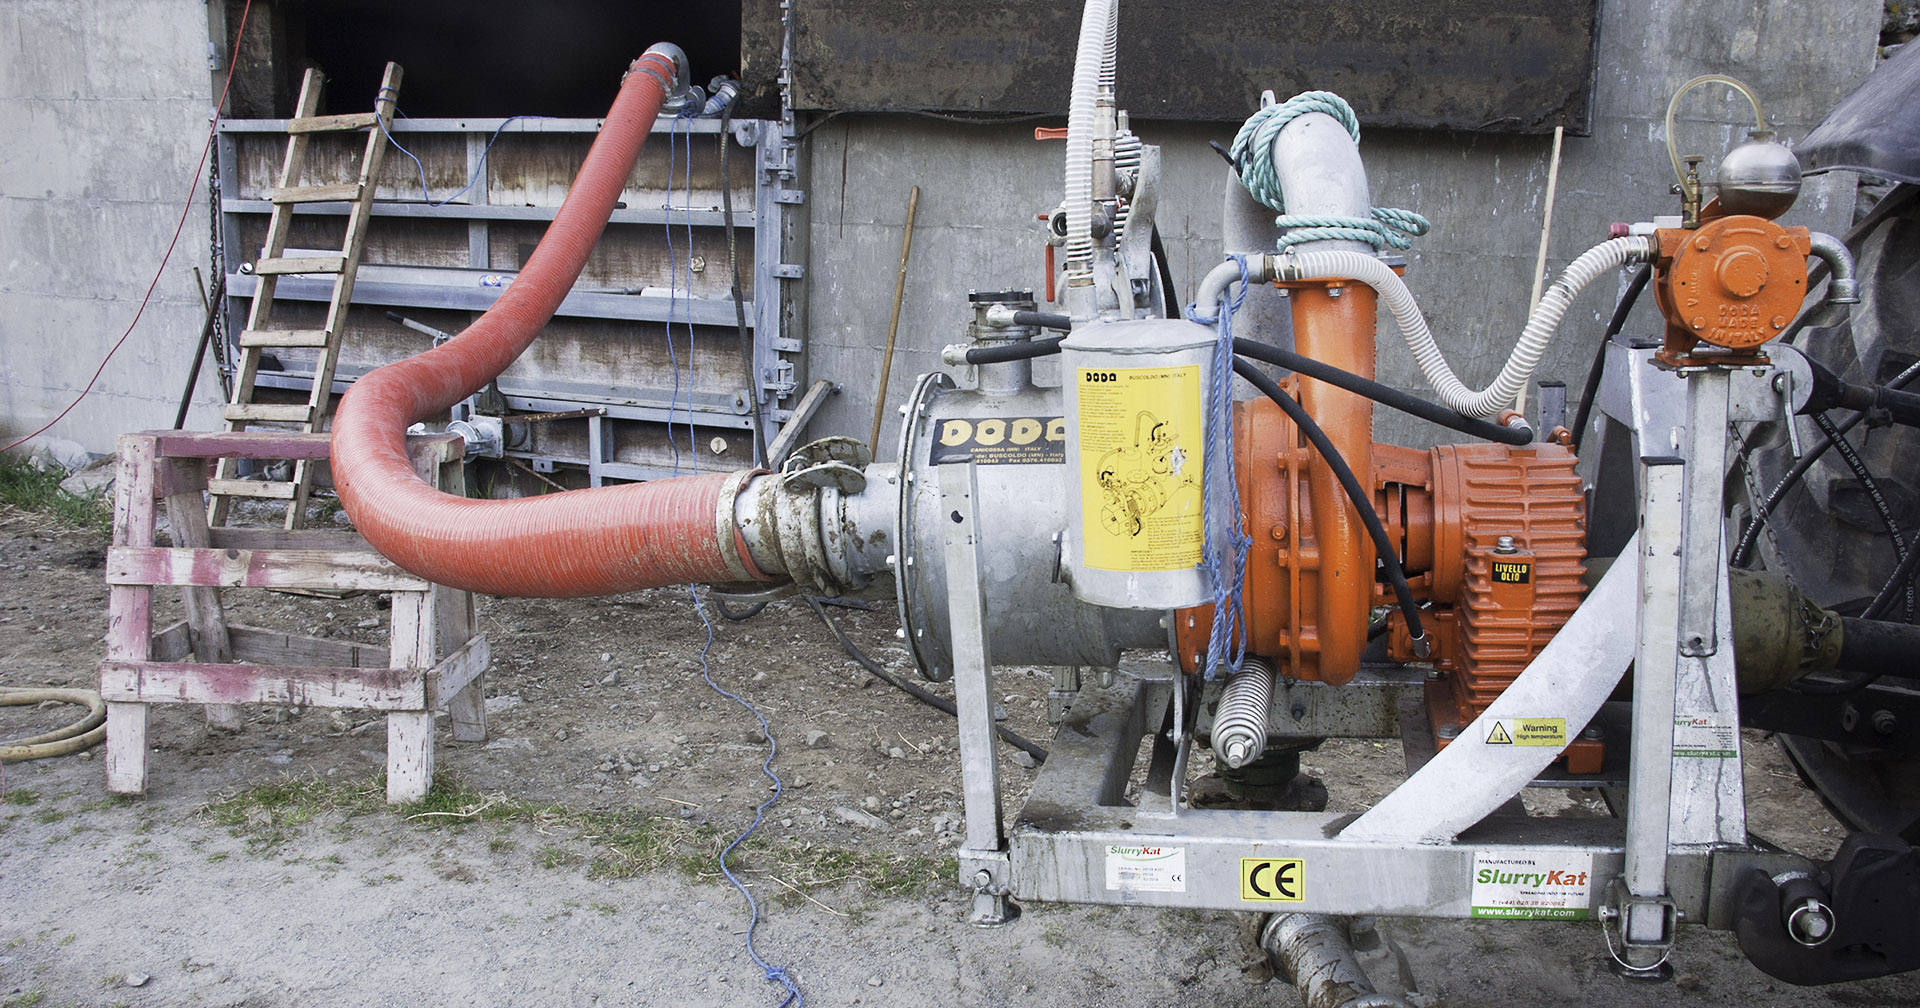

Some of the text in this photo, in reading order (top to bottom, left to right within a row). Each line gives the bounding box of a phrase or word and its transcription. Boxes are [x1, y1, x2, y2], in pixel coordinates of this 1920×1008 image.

[1085, 372, 1117, 383] DODA
[1495, 563, 1528, 574] LIVELLO
[1501, 572, 1520, 582] OLIO
[1674, 718, 1707, 727] urryKat
[1522, 724, 1558, 733] Warning
[1110, 845, 1161, 856] SlurryKat
[1249, 862, 1296, 898] CE
[1476, 868, 1588, 888] SlurryKat
[1477, 907, 1576, 917] www.slurrykat.com
